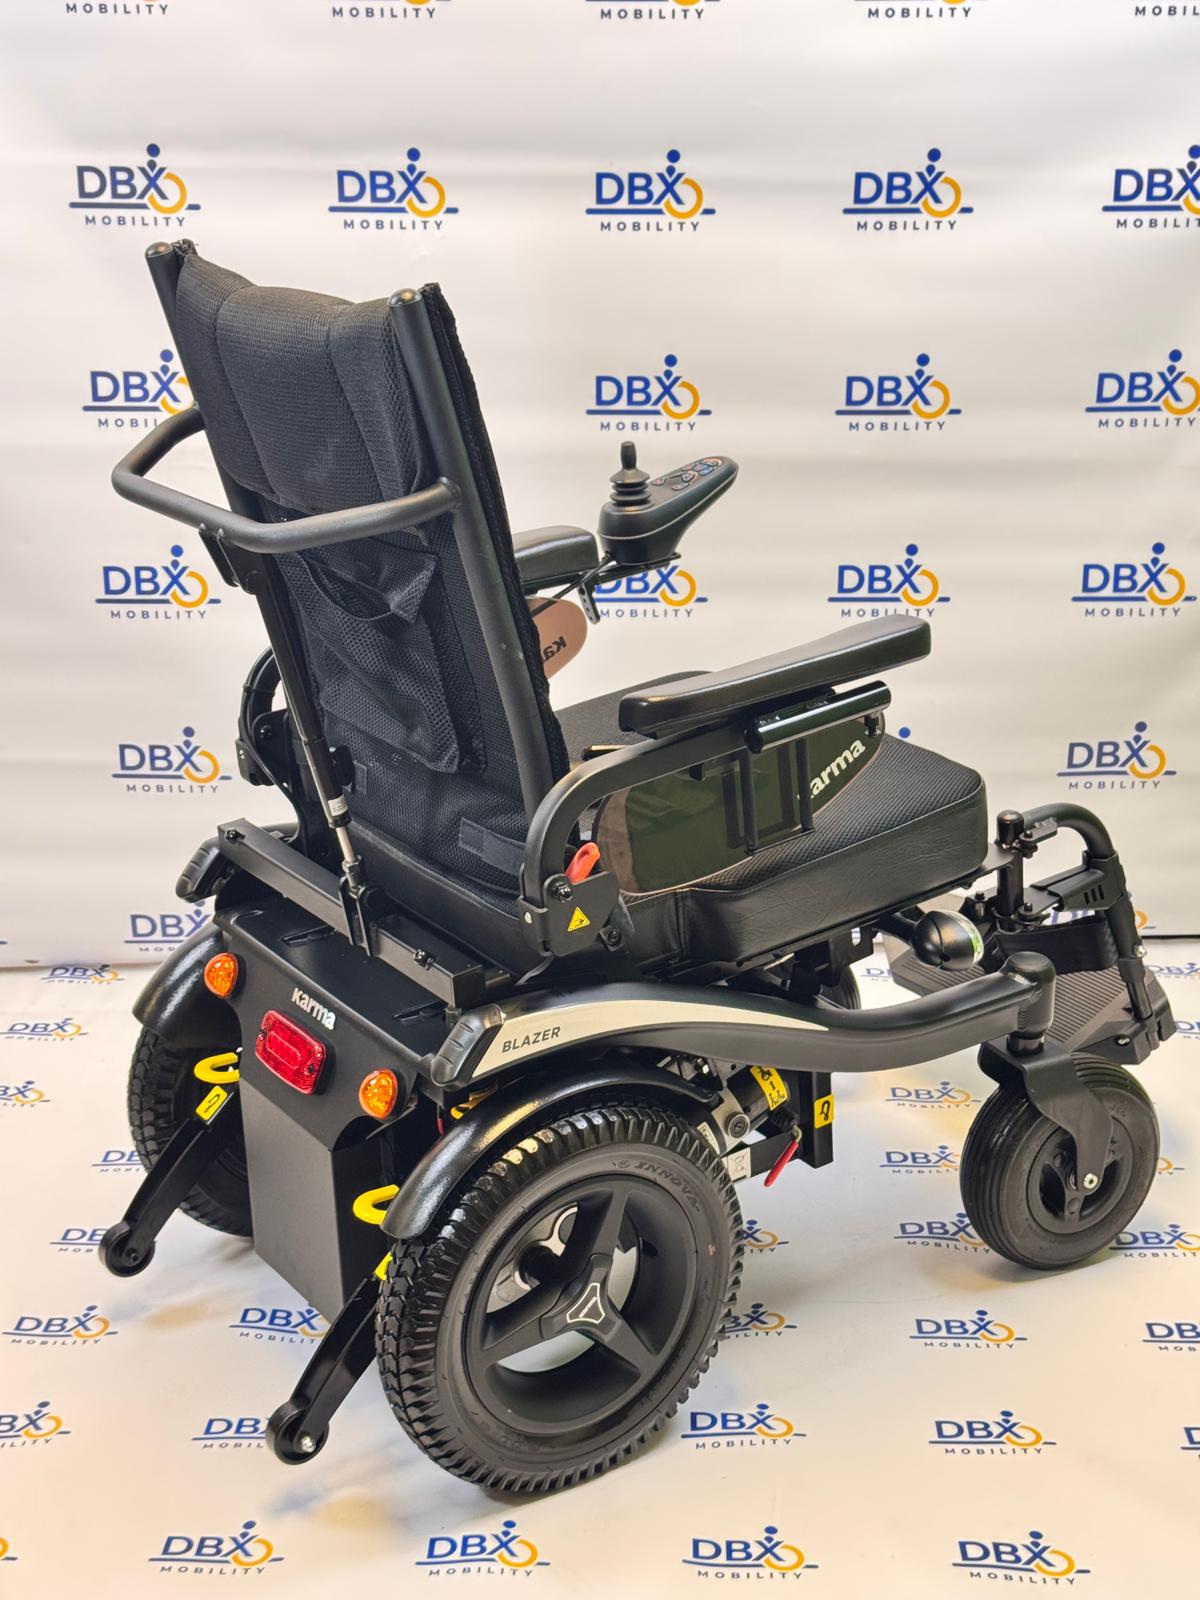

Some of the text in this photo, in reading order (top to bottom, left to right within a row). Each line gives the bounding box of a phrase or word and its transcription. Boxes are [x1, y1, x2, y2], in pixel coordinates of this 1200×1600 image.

[66, 4, 168, 15] MOBILITY
[332, 7, 436, 18] MOBILITY
[600, 8, 705, 20] MOBILITY
[867, 7, 973, 19] MOBILITY
[1134, 5, 1200, 17] MOBIL
[76, 165, 170, 200] DBX
[336, 169, 429, 204] DBX
[595, 172, 685, 205] DBX
[852, 171, 945, 204] DBX
[85, 215, 186, 227] MOBILITY
[343, 219, 443, 231] MOBILITY
[600, 221, 700, 231] MOBILITY
[856, 220, 958, 230] MOBILITY
[90, 370, 180, 403] DBX
[595, 376, 681, 406] DBX
[845, 376, 932, 406] DBX
[1095, 371, 1185, 403] DBX
[97, 418, 158, 428] MOBIL
[600, 421, 696, 431] MOBILITY
[848, 421, 947, 431] MOBILITY
[1098, 418, 1195, 428] MOBILITY
[102, 566, 190, 596] DBX
[836, 564, 921, 594] DBX
[1081, 563, 1170, 593] DBX
[110, 609, 207, 619] MOBILITY
[600, 609, 694, 618] MOBILITY
[1085, 607, 1181, 617] MOBILITY
[118, 744, 202, 771] DBX
[1066, 741, 1148, 769] DBX
[797, 739, 866, 799] arma
[126, 783, 219, 793] MOBILITY
[1068, 780, 1160, 790] MOBILITY
[8, 1023, 70, 1032] DBX
[501, 1026, 561, 1053] BLAZER
[890, 1087, 959, 1100] DBX
[885, 1151, 957, 1165] DBX
[900, 1221, 976, 1239] DBX
[14, 1316, 96, 1333] DBX
[239, 1308, 320, 1331] DBX
[915, 1318, 1000, 1335] DBX
[239, 1331, 316, 1344] MOBILIT
[1145, 1322, 1200, 1339] DB
[10, 1337, 102, 1346] MOBILITY
[0, 1412, 51, 1433] BX
[203, 1417, 269, 1435] DB
[690, 1411, 778, 1432] DBX
[935, 1420, 1025, 1440] DBX
[695, 1439, 792, 1450] MOBILITY
[944, 1447, 1043, 1456] MOBILITY
[160, 1535, 258, 1556] DBX
[427, 1533, 520, 1560] DBX
[691, 1538, 790, 1563] DBX
[958, 1540, 1057, 1567] DBX
[160, 1565, 266, 1575] MOBILITY
[429, 1567, 535, 1577] MOBILITY
[697, 1570, 803, 1580] MOBILITY
[969, 1571, 1076, 1585] MOBILITY
